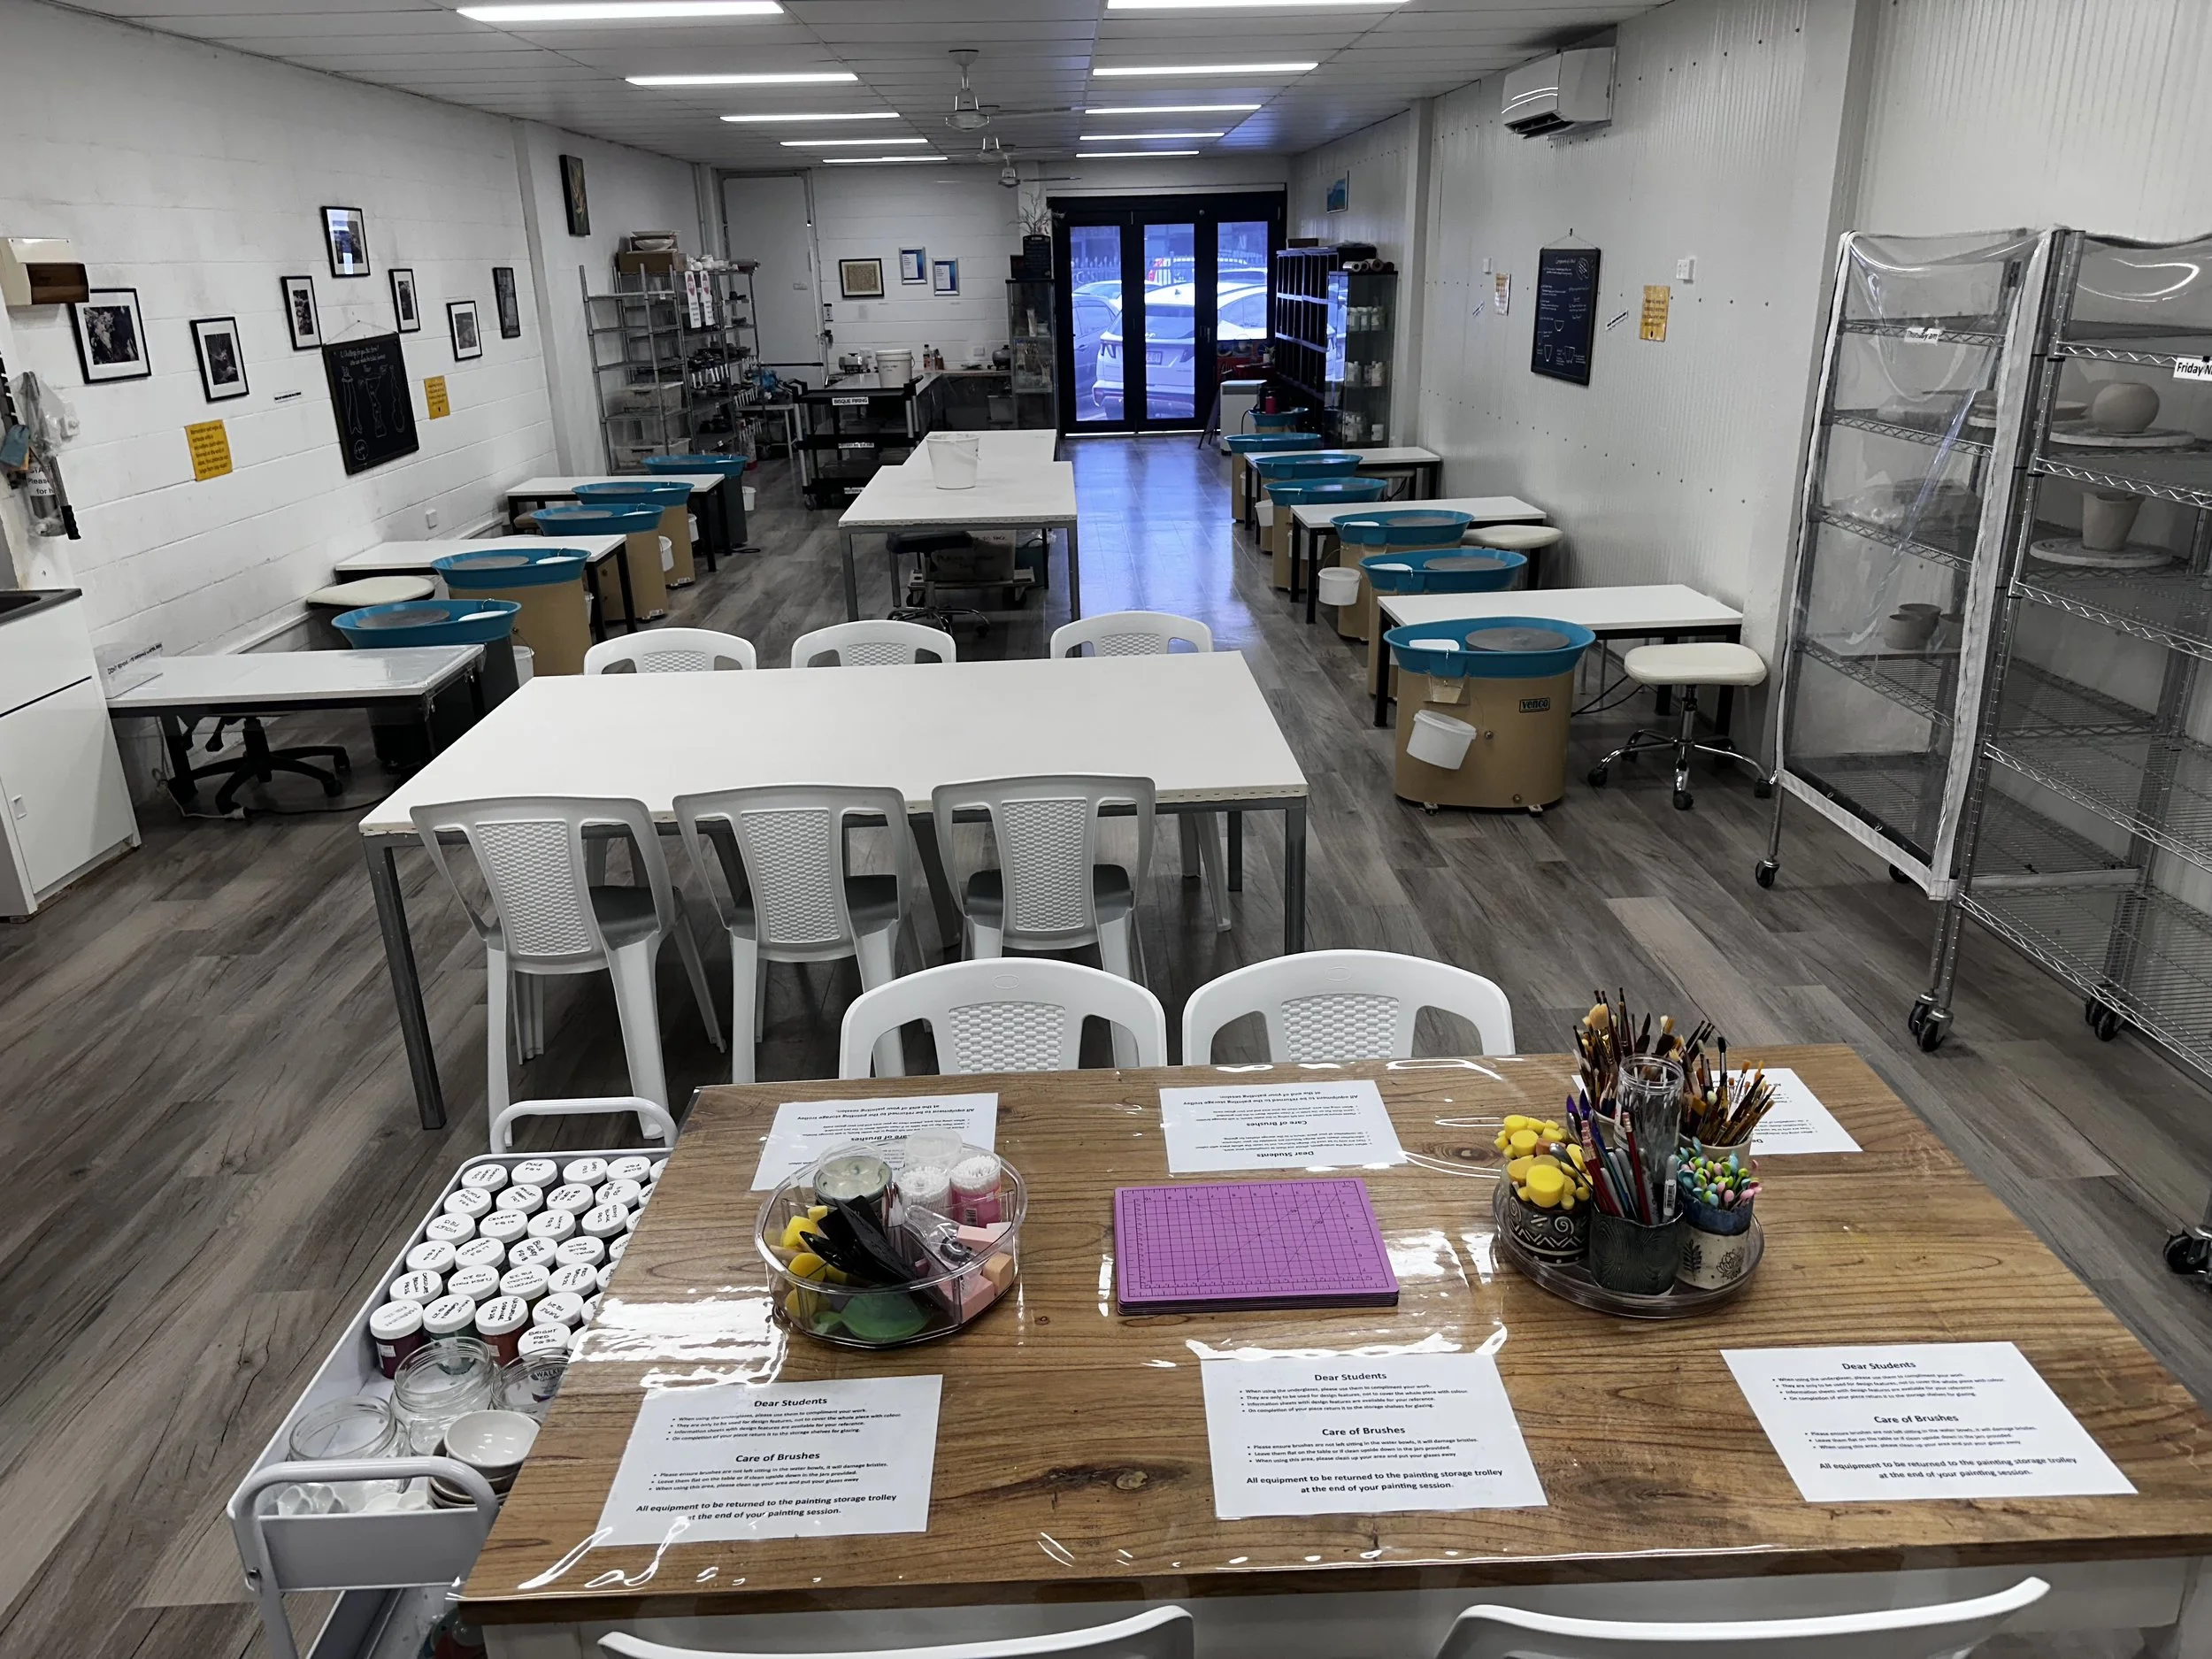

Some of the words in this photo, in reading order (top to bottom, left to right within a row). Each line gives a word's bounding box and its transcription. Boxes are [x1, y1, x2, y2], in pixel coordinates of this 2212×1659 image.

[2177, 363, 2203, 376] Friday
[435, 1225, 457, 1233] VIOLET
[781, 1398, 827, 1406] Students
[777, 1452, 819, 1460] Brushes
[767, 1509, 804, 1517] painting
